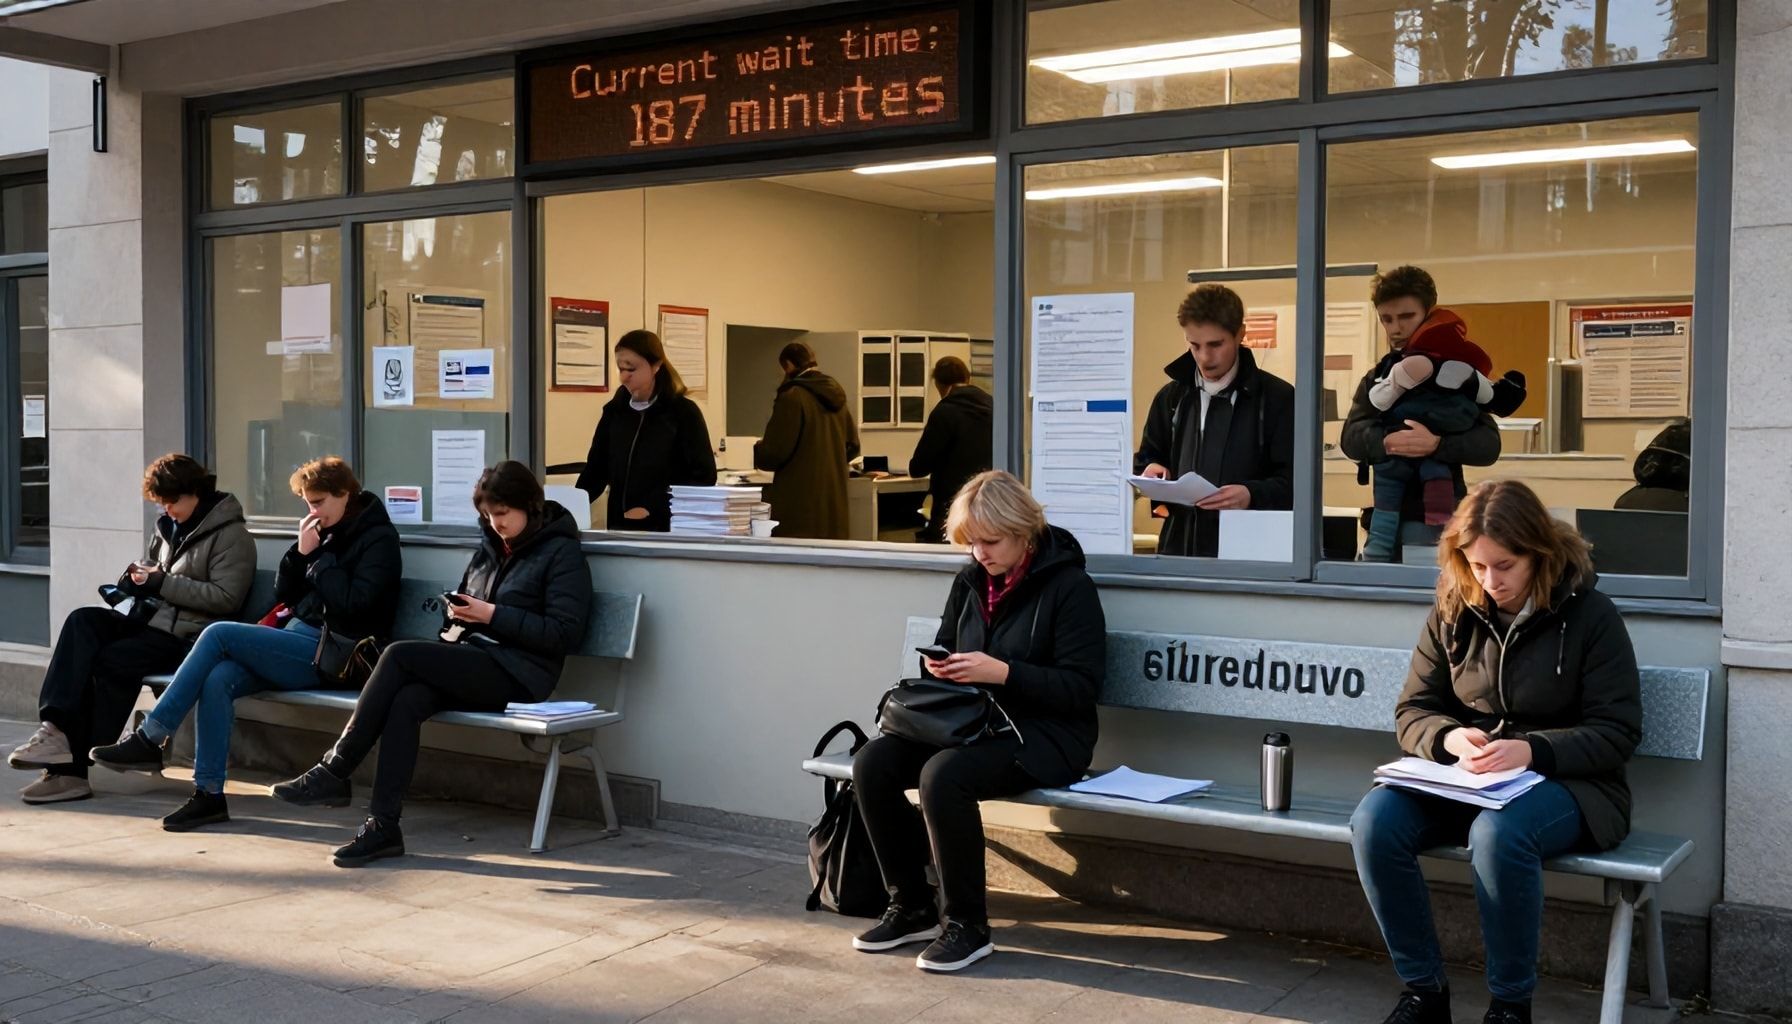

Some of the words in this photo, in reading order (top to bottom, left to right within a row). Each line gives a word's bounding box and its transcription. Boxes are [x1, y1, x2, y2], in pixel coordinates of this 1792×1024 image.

[571, 51, 718, 98] Current
[736, 35, 814, 74] wait
[629, 94, 706, 147] 187
[728, 75, 945, 134] minutes
